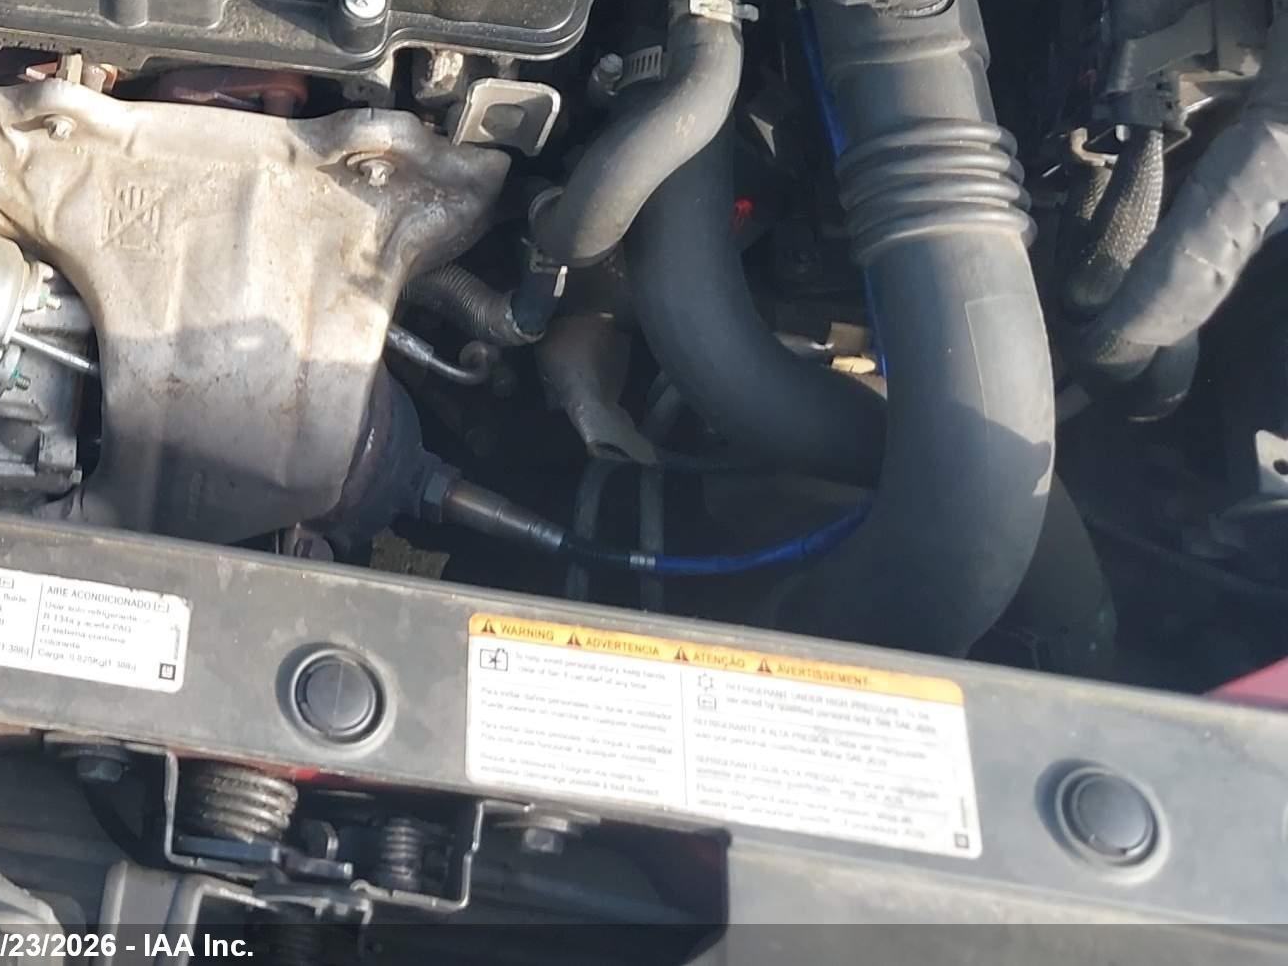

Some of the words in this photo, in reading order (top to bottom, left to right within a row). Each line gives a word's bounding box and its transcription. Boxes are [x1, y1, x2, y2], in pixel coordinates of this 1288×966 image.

[47, 586, 69, 595] AIRE
[71, 590, 151, 610] ACONDICIONADO
[500, 623, 554, 642] WARNING
[585, 637, 659, 656] ADVERTENCIA
[692, 651, 745, 670] ATENÇÃO
[776, 664, 869, 686] AVERTISSEMENT
